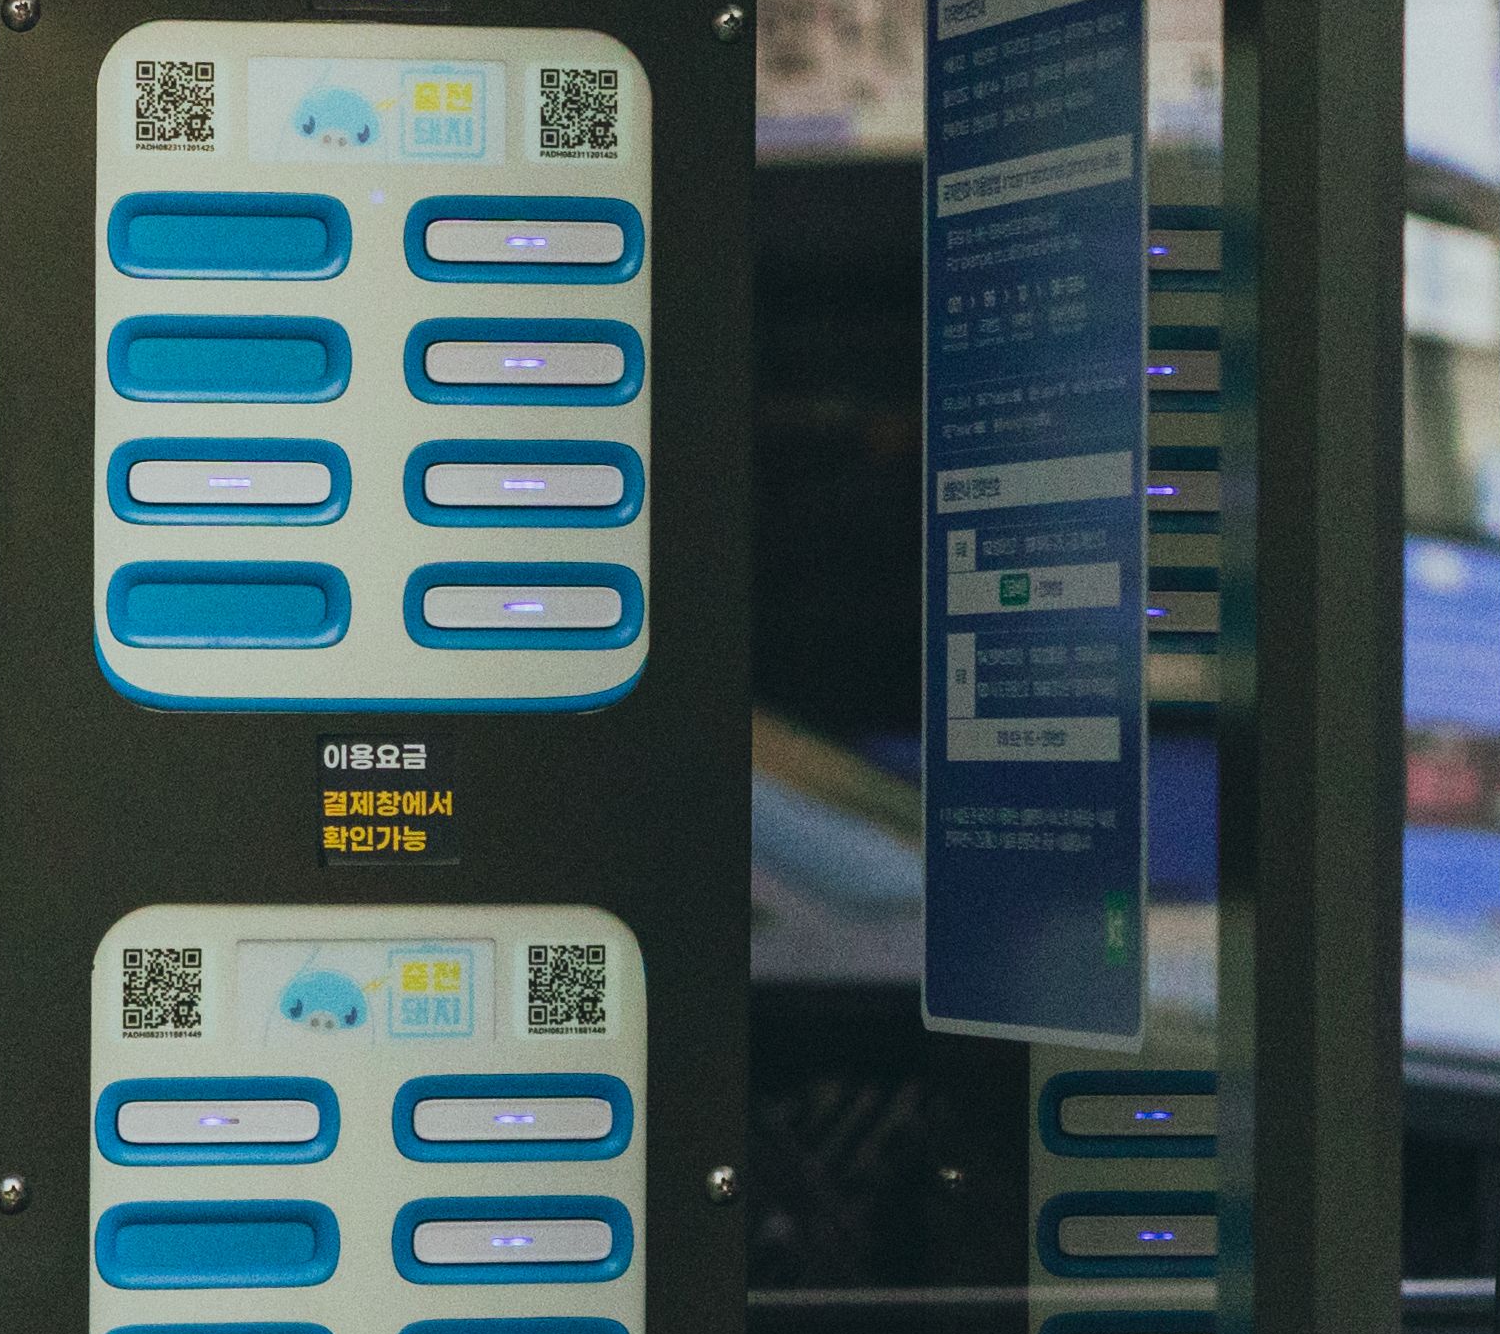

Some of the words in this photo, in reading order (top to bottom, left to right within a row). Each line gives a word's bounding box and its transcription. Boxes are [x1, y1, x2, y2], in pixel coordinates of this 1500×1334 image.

[323, 743, 427, 770] 이용요금
[323, 791, 453, 816] 결제창에서
[323, 826, 426, 852] 확인가능
